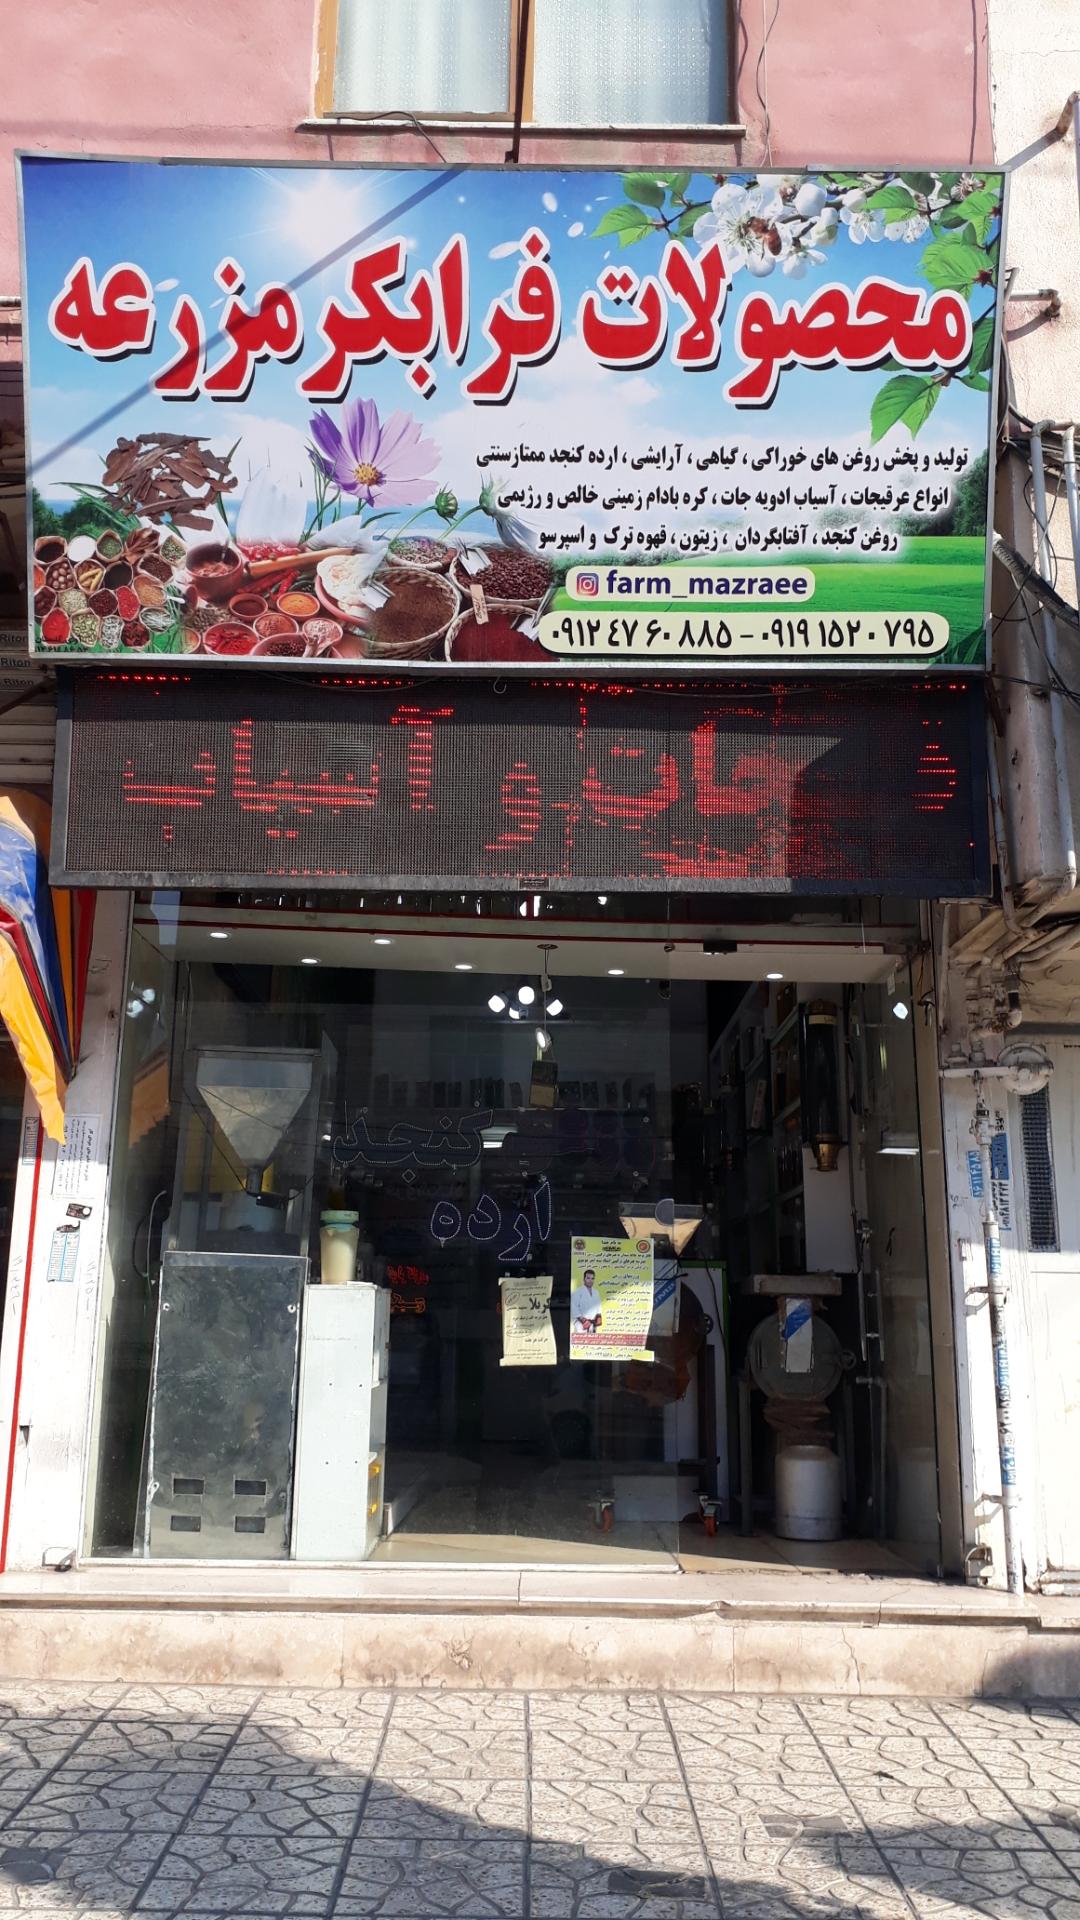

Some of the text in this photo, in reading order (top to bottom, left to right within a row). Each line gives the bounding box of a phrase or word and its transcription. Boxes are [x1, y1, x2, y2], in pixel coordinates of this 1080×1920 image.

[49, 256, 303, 404] مزرعه
[578, 239, 972, 403] محصولات
[549, 444, 585, 469] کنجد
[588, 445, 618, 470] ارده
[631, 443, 683, 471] آرایشی
[696, 446, 739, 472] گیاهی
[751, 446, 807, 472] خوراکی
[810, 447, 839, 472] های
[842, 447, 879, 472] روغن
[883, 447, 918, 472] پخش
[922, 455, 930, 467] و
[934, 447, 968, 472] تولید
[498, 484, 542, 509] رژیمی
[546, 493, 554, 509] و
[557, 484, 599, 510] خالص
[602, 487, 643, 510] زمینی
[646, 486, 679, 511] بادام
[683, 486, 709, 511] کره
[721, 486, 751, 511] جات
[755, 486, 791, 512] ادویه
[794, 484, 838, 511] آسیاب
[850, 486, 910, 512] عرقیجات
[912, 486, 949, 511] انواع
[538, 525, 585, 550] اسپرسو
[589, 533, 596, 549] و
[604, 525, 634, 550] ترک
[636, 525, 667, 550] قهوه
[679, 527, 718, 551] زیتون
[735, 524, 808, 551] آفتابگردان
[821, 526, 858, 551] کنجد
[860, 526, 898, 551] روغن
[606, 569, 808, 598] farm_mazraee
[1, 657, 31, 667] Riton
[333, 1108, 494, 1183] کنجد
[430, 1181, 552, 1261] ارده
